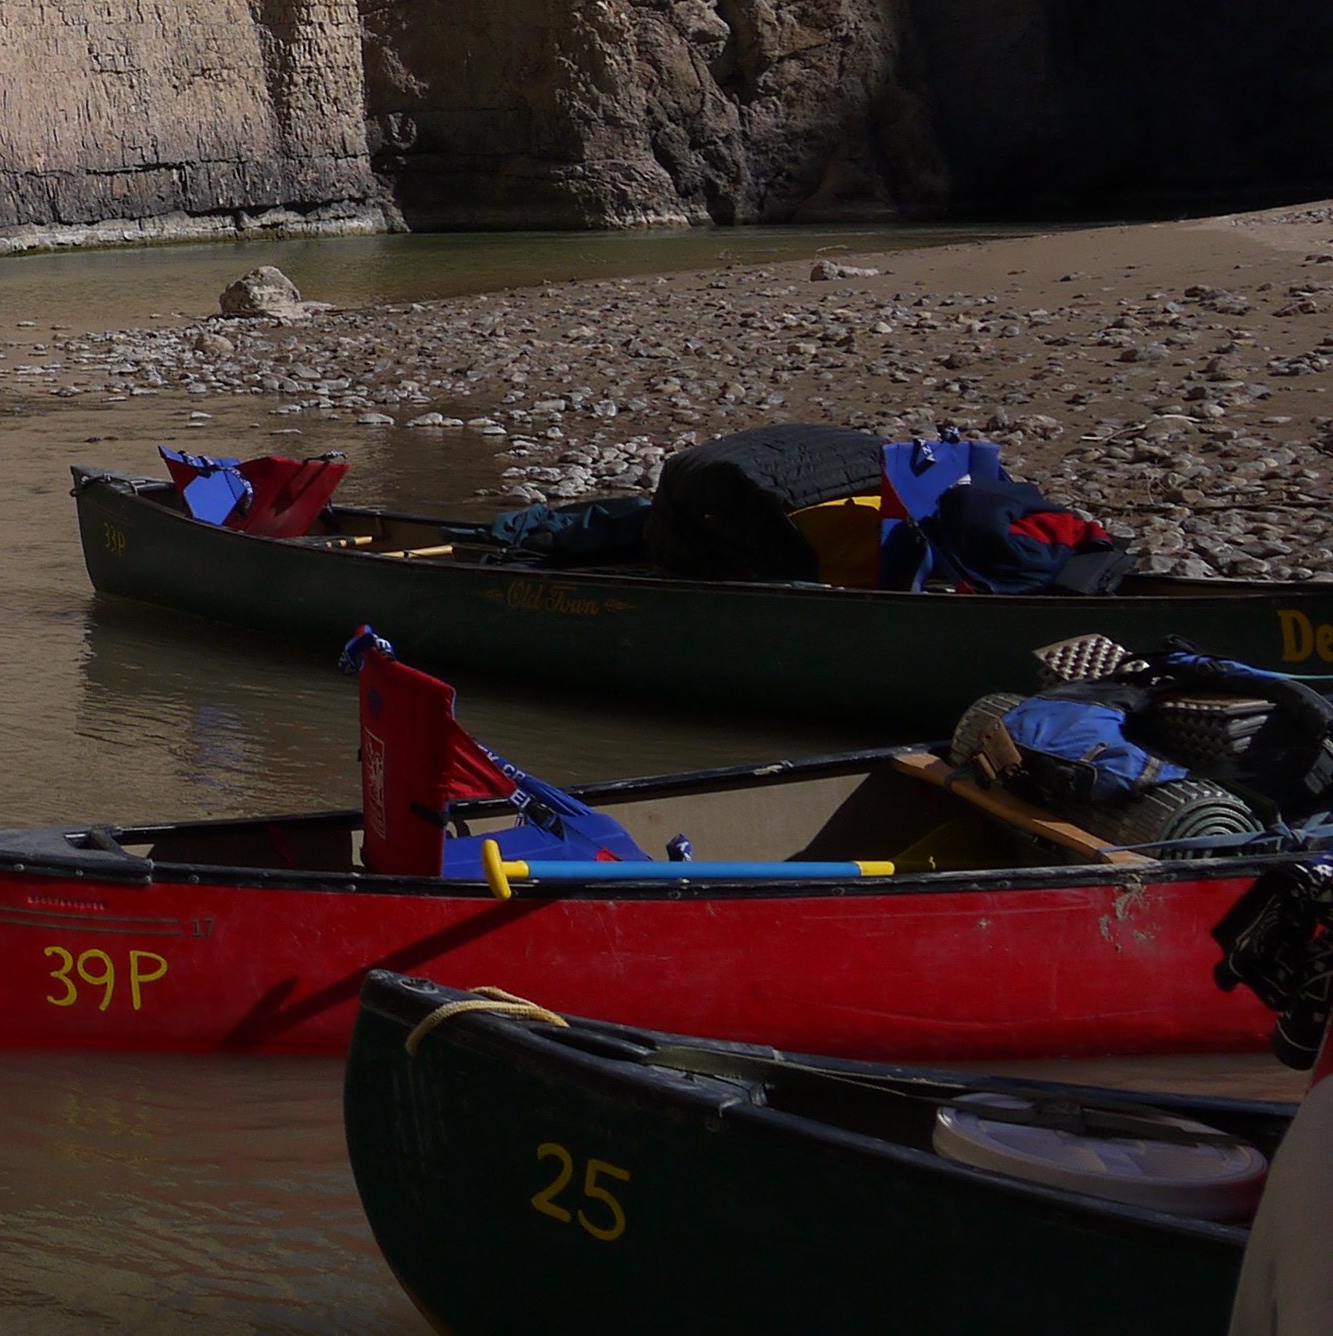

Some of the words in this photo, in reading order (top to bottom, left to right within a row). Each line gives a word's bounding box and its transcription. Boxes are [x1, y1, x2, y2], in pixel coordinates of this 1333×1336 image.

[507, 580, 545, 609] Old
[545, 584, 598, 615] Town
[191, 919, 215, 937] 17
[44, 946, 169, 1011] 39P
[531, 1142, 630, 1241] 25
